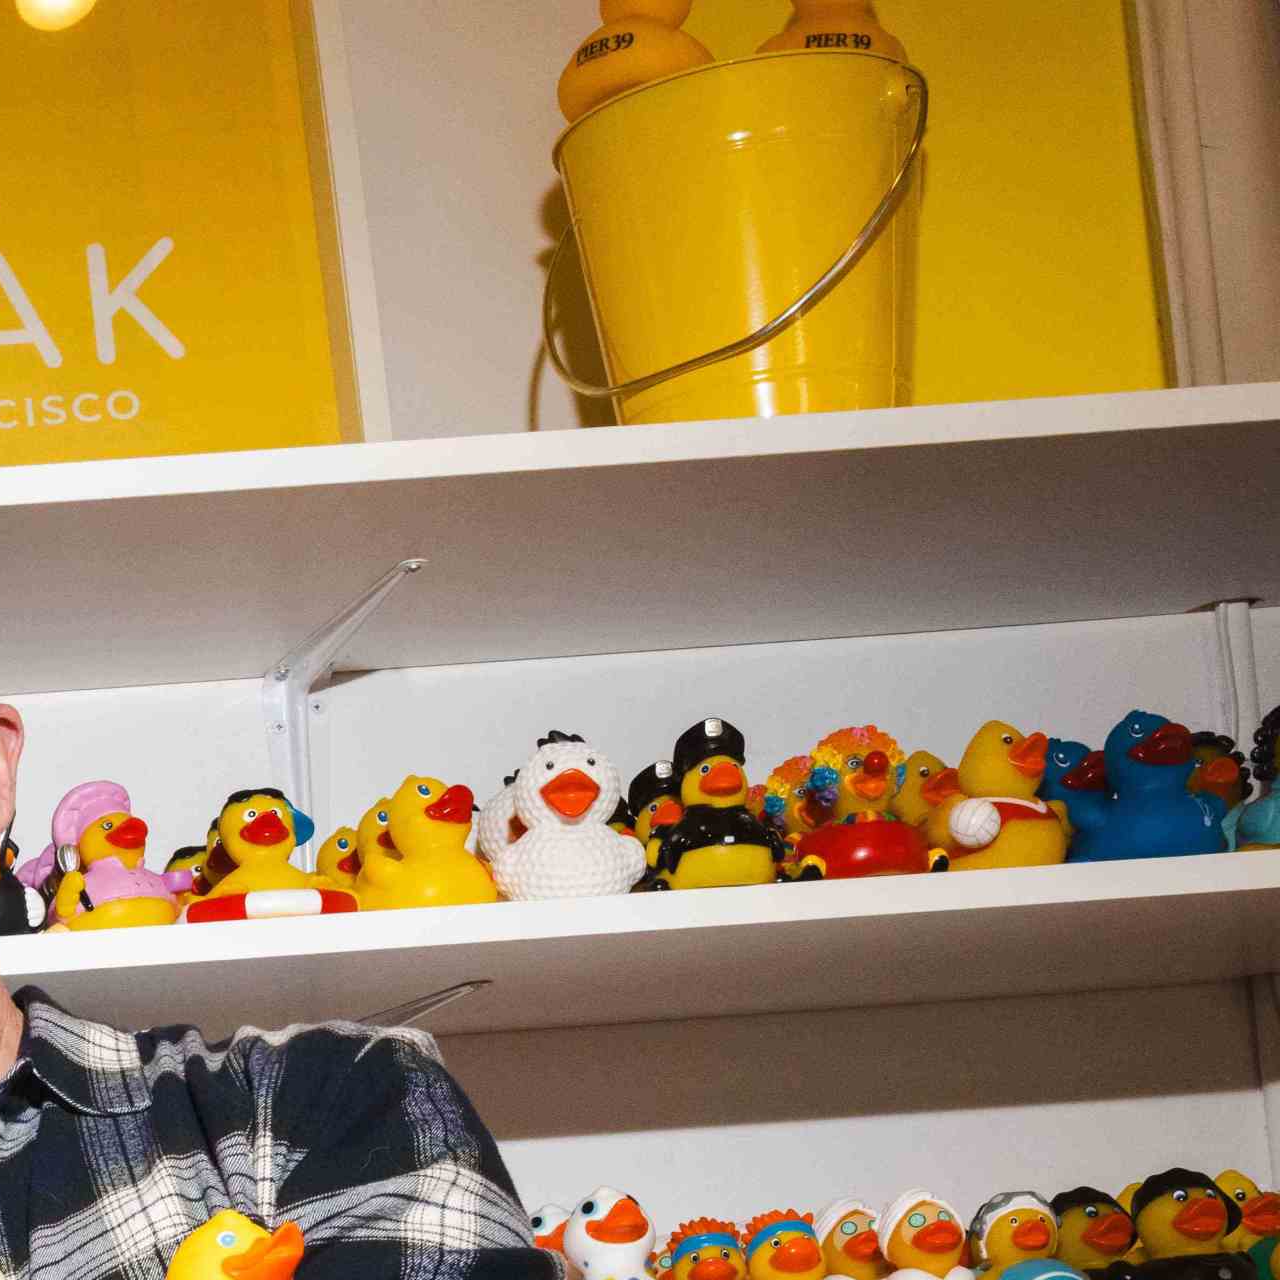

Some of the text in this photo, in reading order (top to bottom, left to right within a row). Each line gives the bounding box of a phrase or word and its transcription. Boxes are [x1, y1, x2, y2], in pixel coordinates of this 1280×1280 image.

[576, 32, 634, 64] PIER 39
[804, 32, 871, 49] PIER 39
